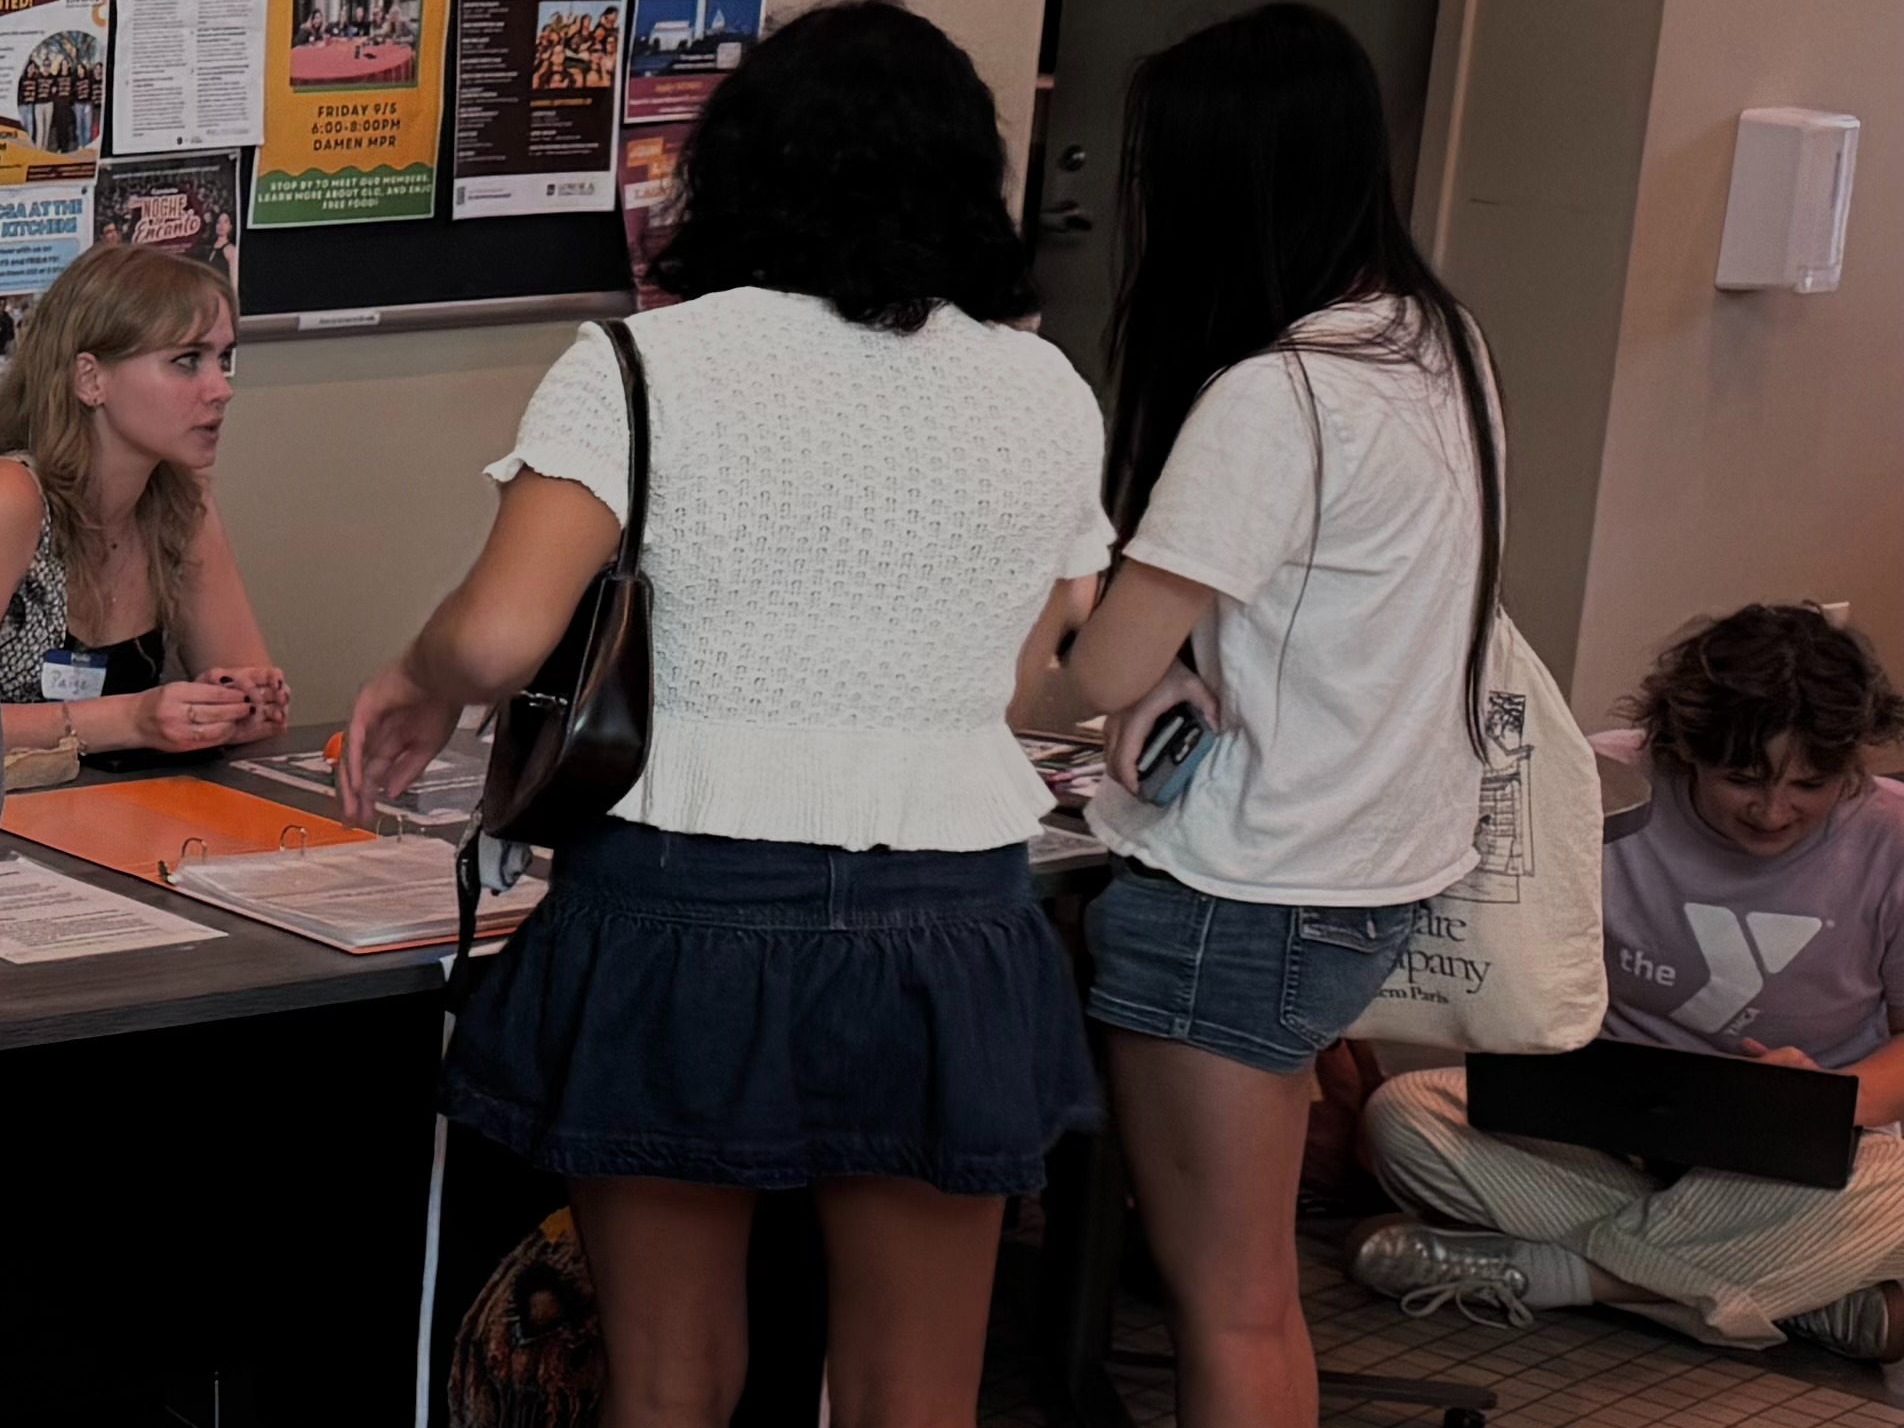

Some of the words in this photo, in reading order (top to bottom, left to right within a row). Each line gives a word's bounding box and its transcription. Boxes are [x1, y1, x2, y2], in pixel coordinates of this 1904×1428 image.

[317, 105, 370, 119] FRIDAY
[311, 119, 402, 136] 6:00-8:00PM
[313, 138, 364, 152] DAMEN
[367, 136, 397, 149] MPR
[270, 179, 298, 192] STOP
[315, 178, 329, 189] TO
[331, 177, 357, 188] MEET
[359, 176, 380, 187] OUR
[257, 192, 293, 203] LEARN
[295, 190, 323, 201] MORE
[325, 188, 358, 199] ABOUT
[386, 185, 406, 195] AND
[28, 200, 53, 218] AT
[53, 198, 83, 216] THE
[321, 200, 346, 210] FREE
[134, 215, 198, 242] Encanto
[1619, 947, 1676, 987] the
